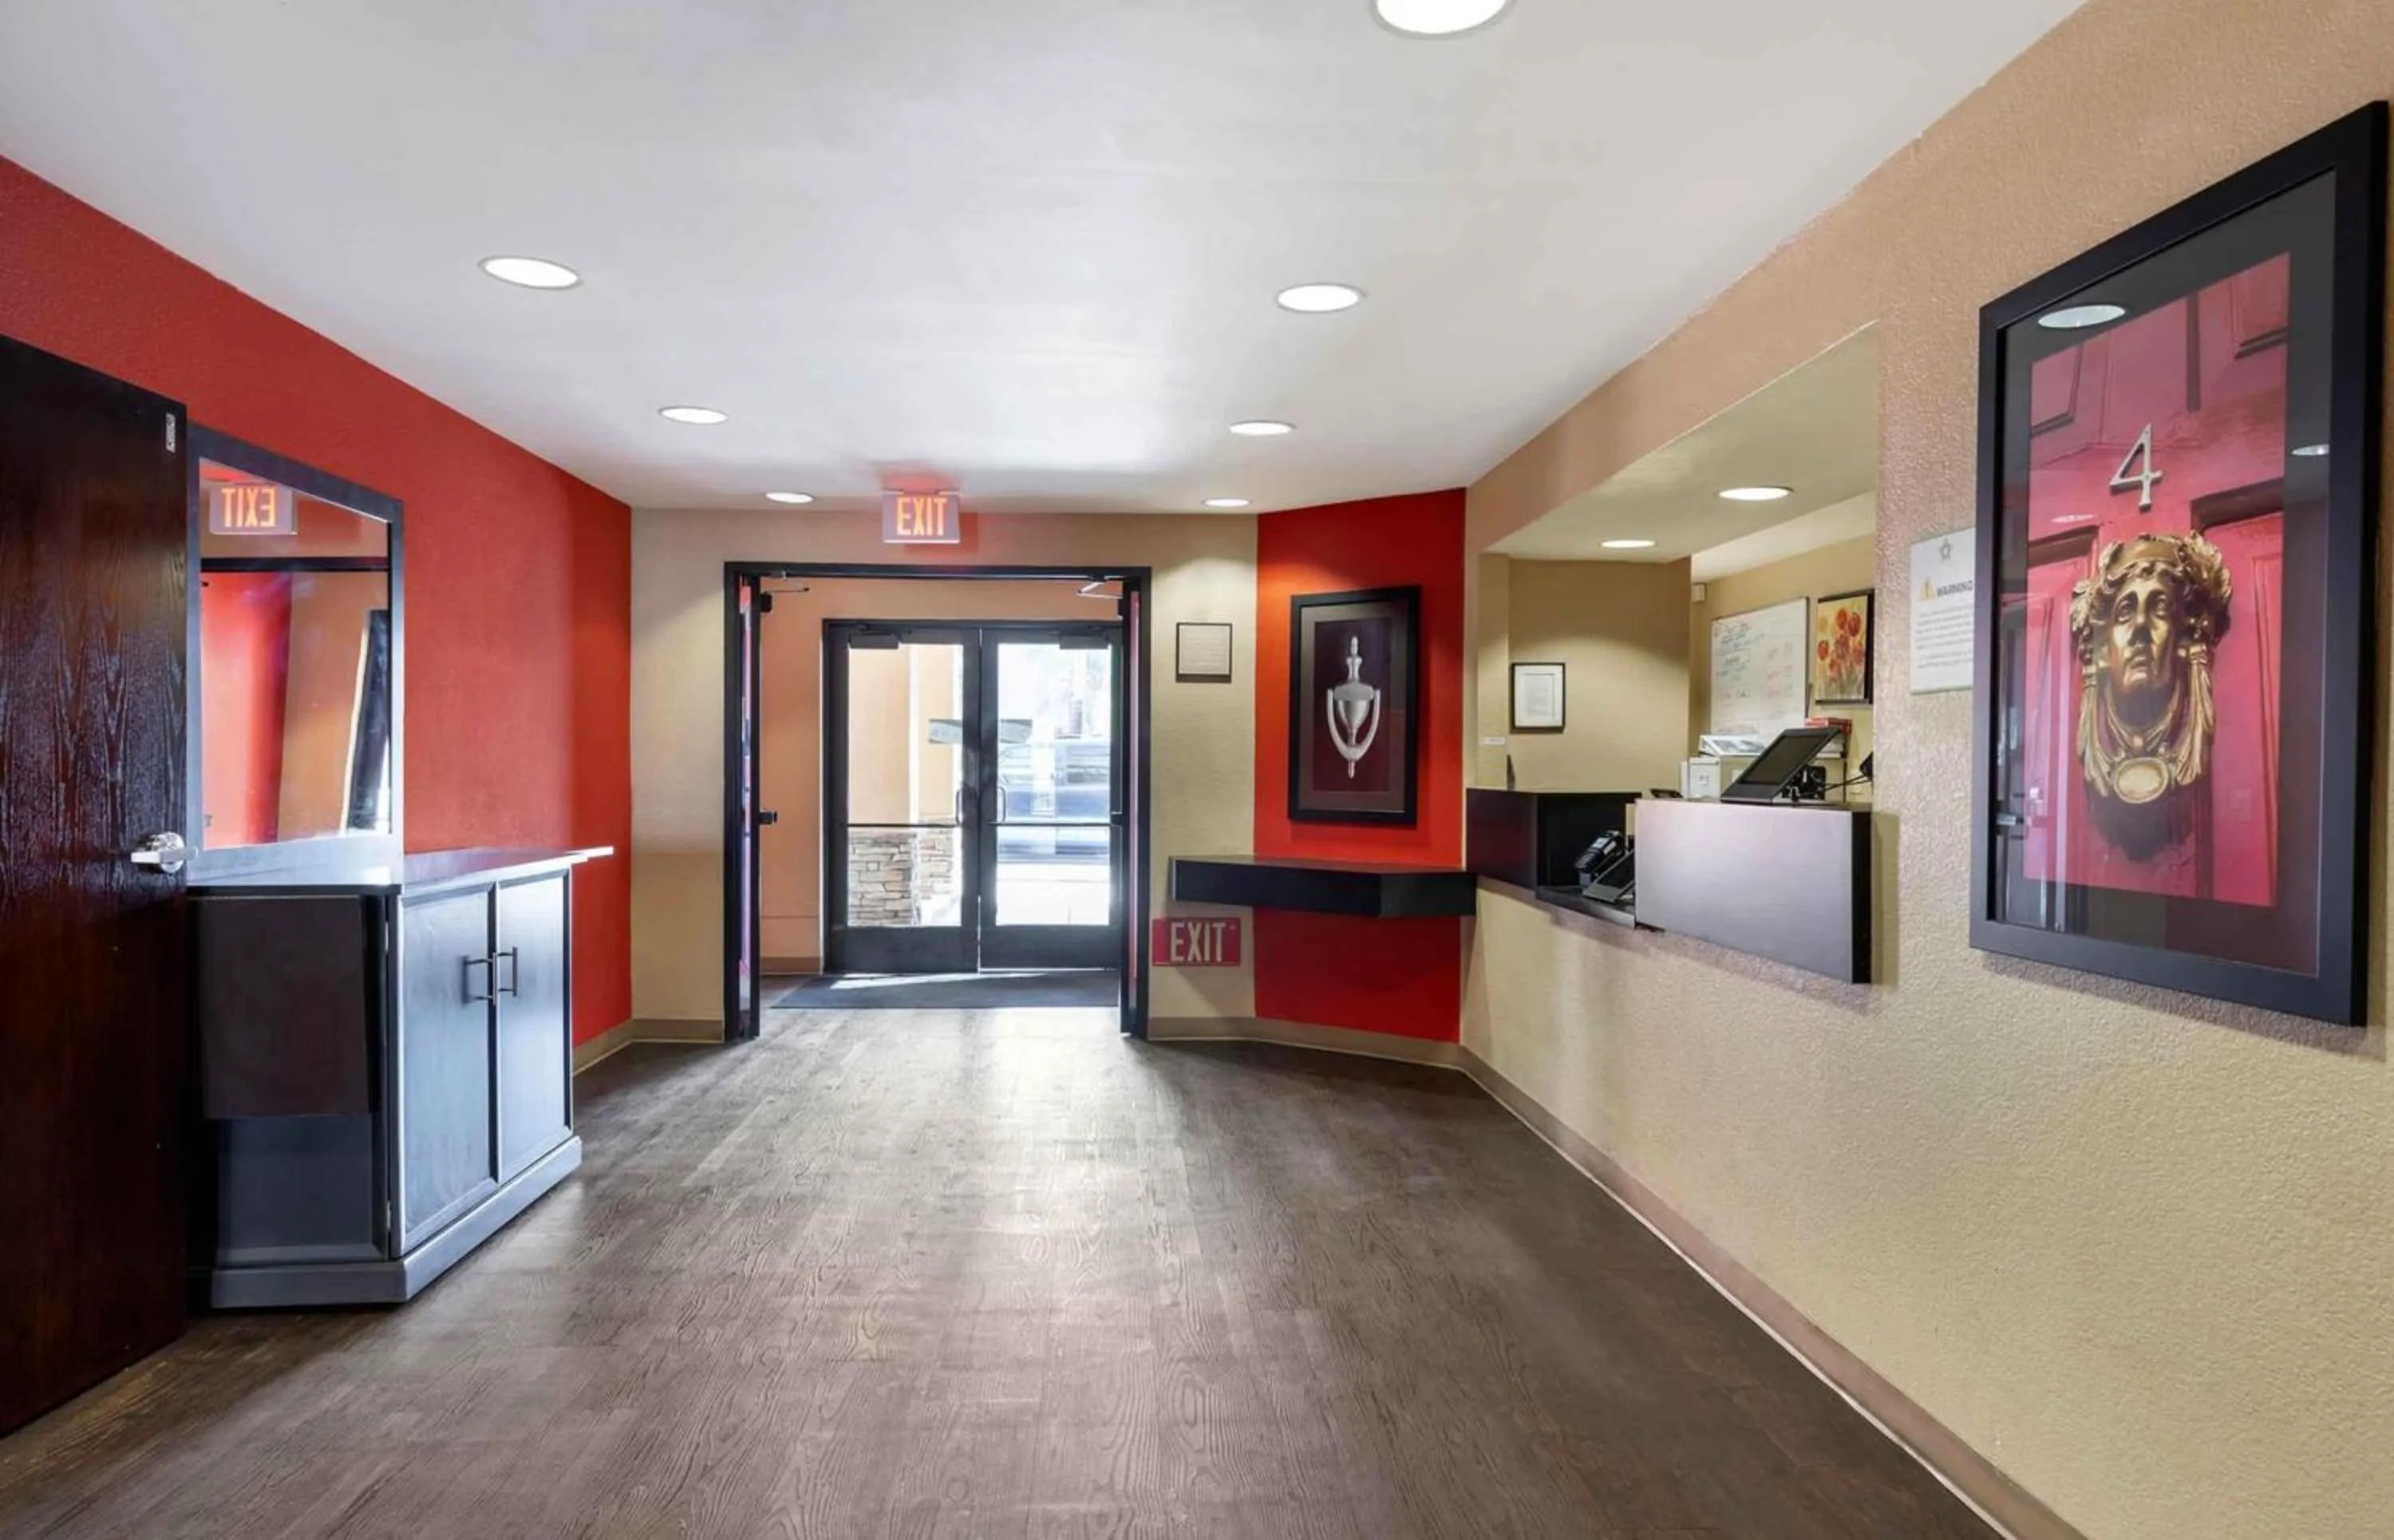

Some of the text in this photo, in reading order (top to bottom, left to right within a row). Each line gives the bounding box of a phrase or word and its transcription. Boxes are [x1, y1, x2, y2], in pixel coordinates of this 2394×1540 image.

[2109, 422, 2164, 512] 4
[897, 496, 947, 536] EXIT
[1170, 921, 1226, 962] EXIT
